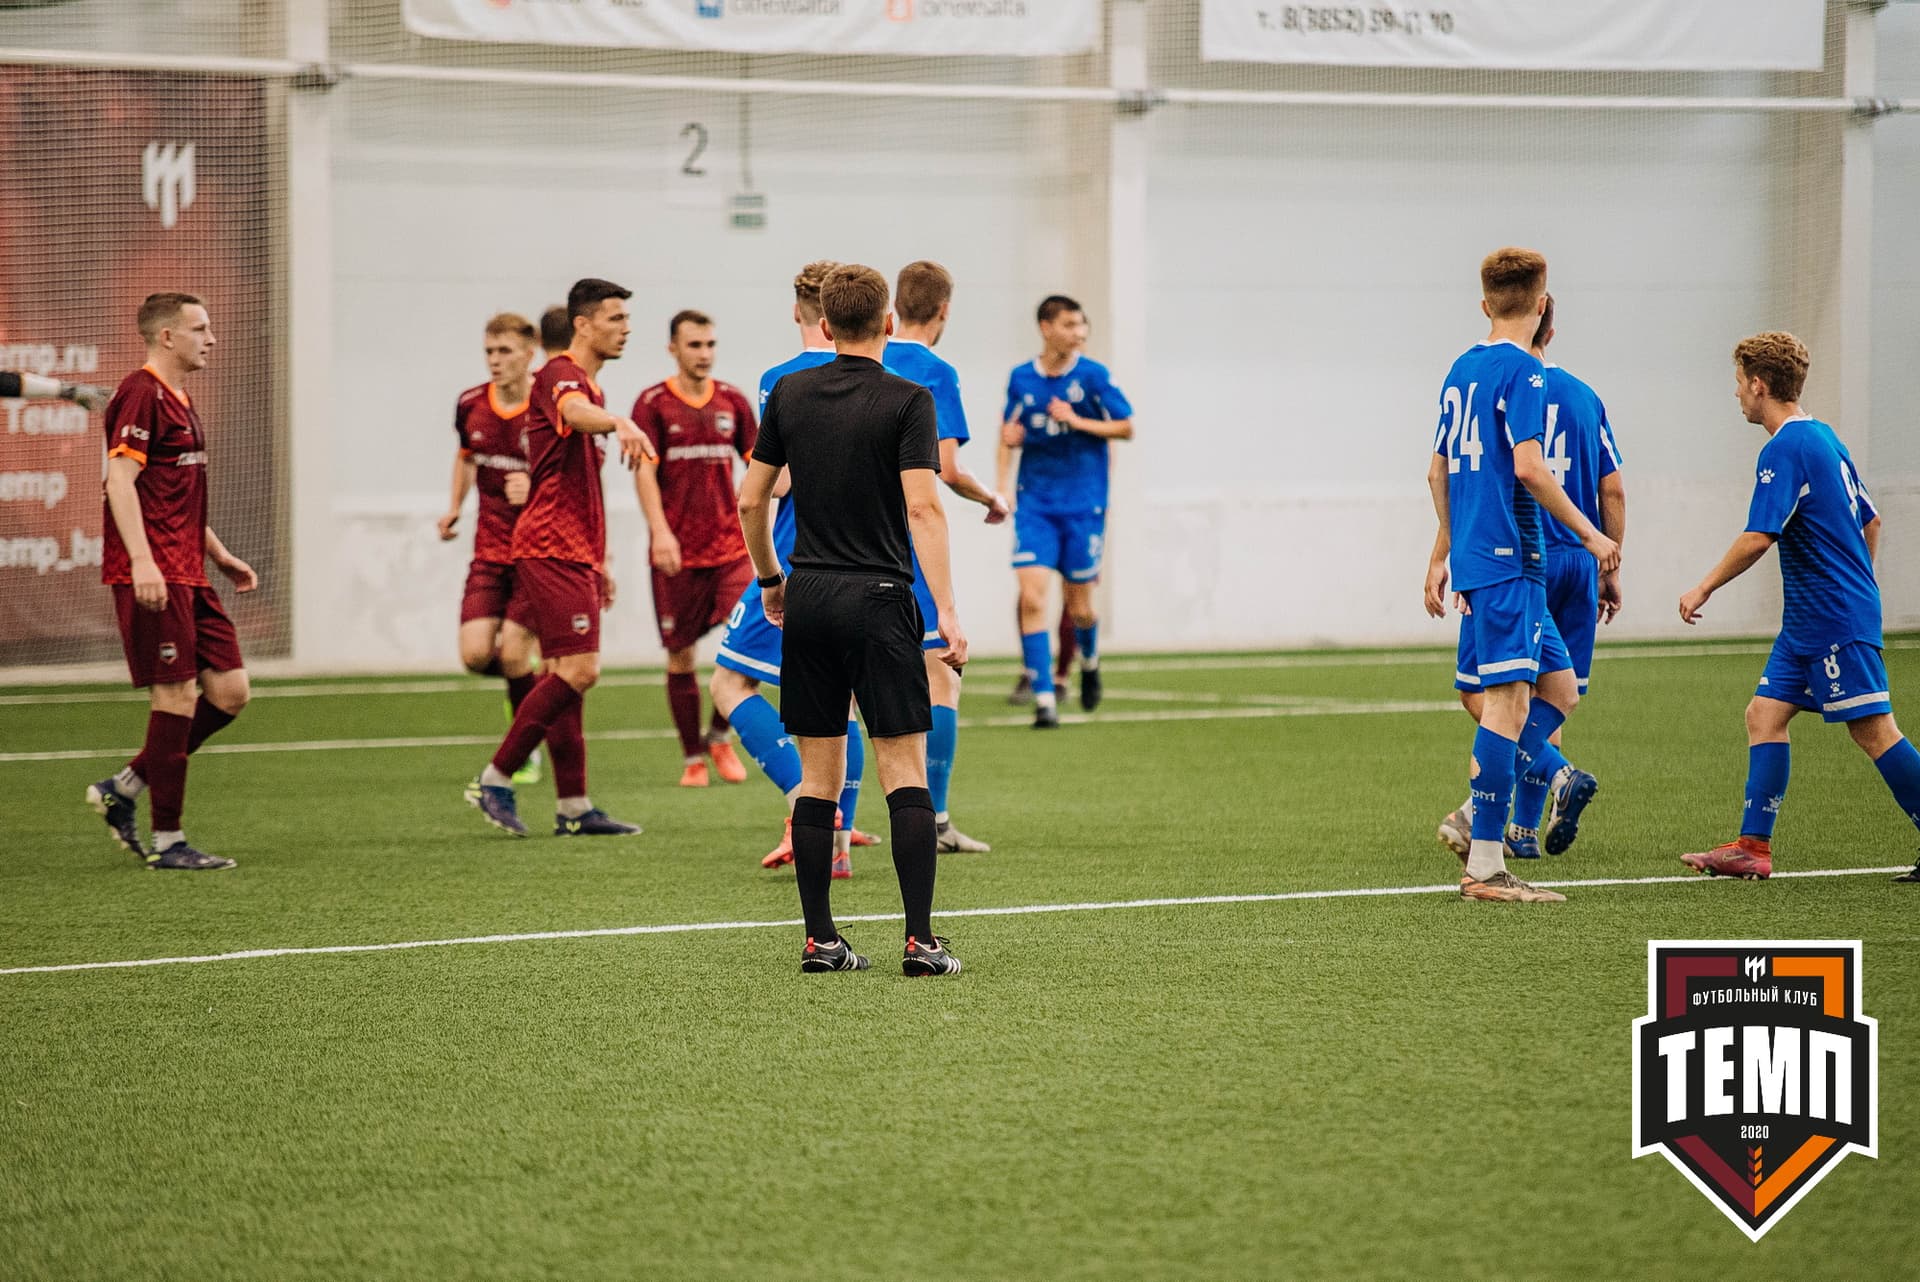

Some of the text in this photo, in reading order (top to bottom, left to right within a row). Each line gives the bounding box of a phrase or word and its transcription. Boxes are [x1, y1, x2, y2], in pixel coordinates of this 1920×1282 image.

[680, 122, 708, 176] 2
[1442, 382, 1484, 474] 24
[1823, 654, 1841, 680] 8
